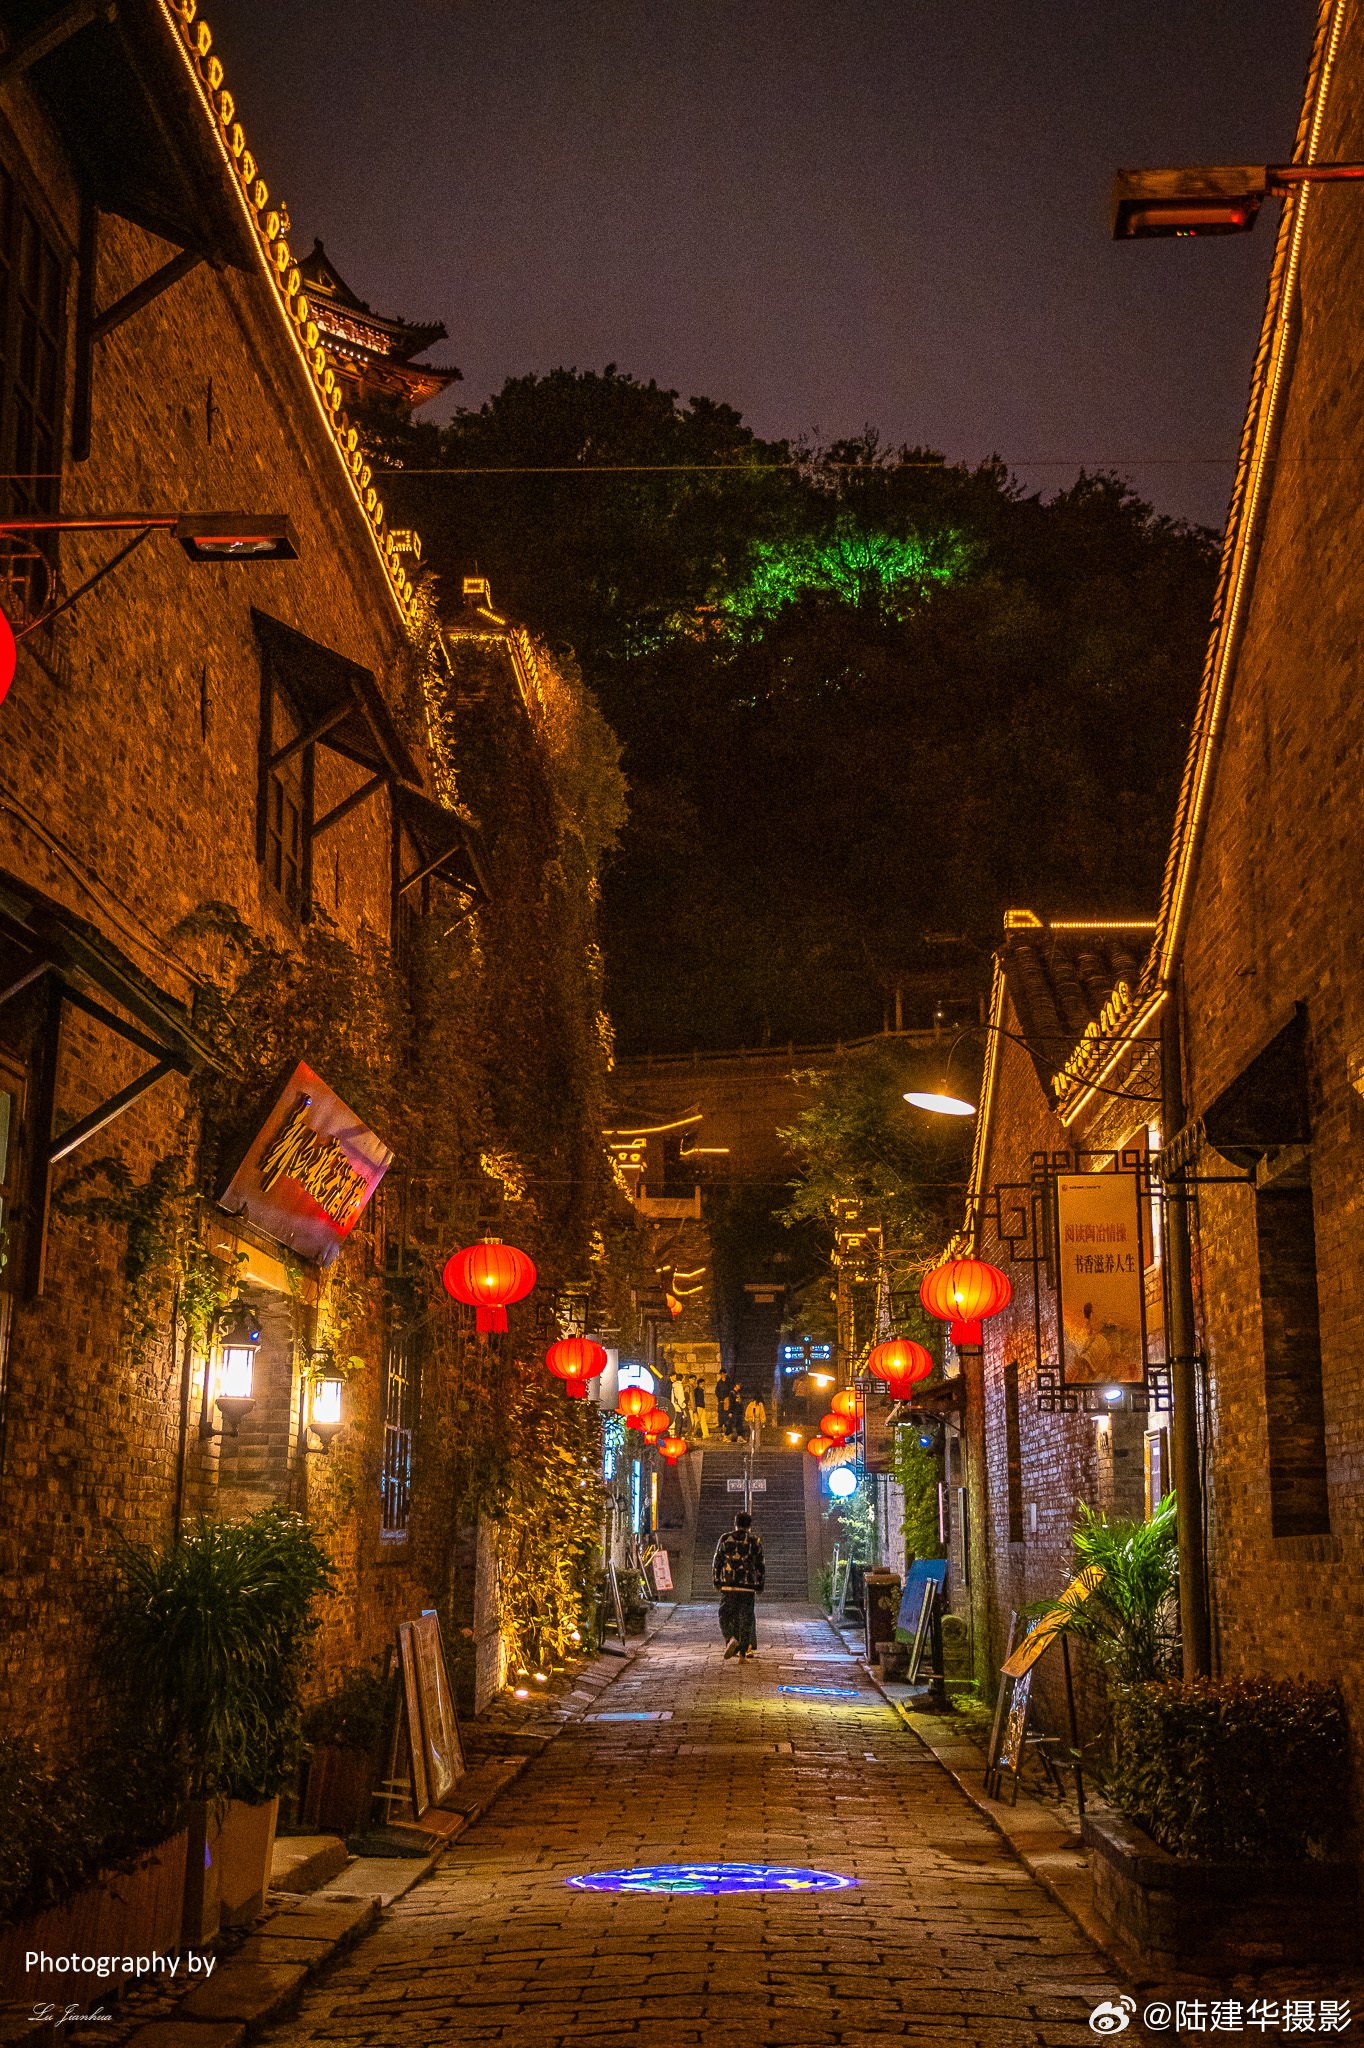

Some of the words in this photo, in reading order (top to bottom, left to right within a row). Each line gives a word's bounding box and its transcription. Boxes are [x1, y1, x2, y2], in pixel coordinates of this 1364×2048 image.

[1064, 1223, 1128, 1243] 阅读陶冶情操
[1073, 1254, 1136, 1274] 书香滋养人生
